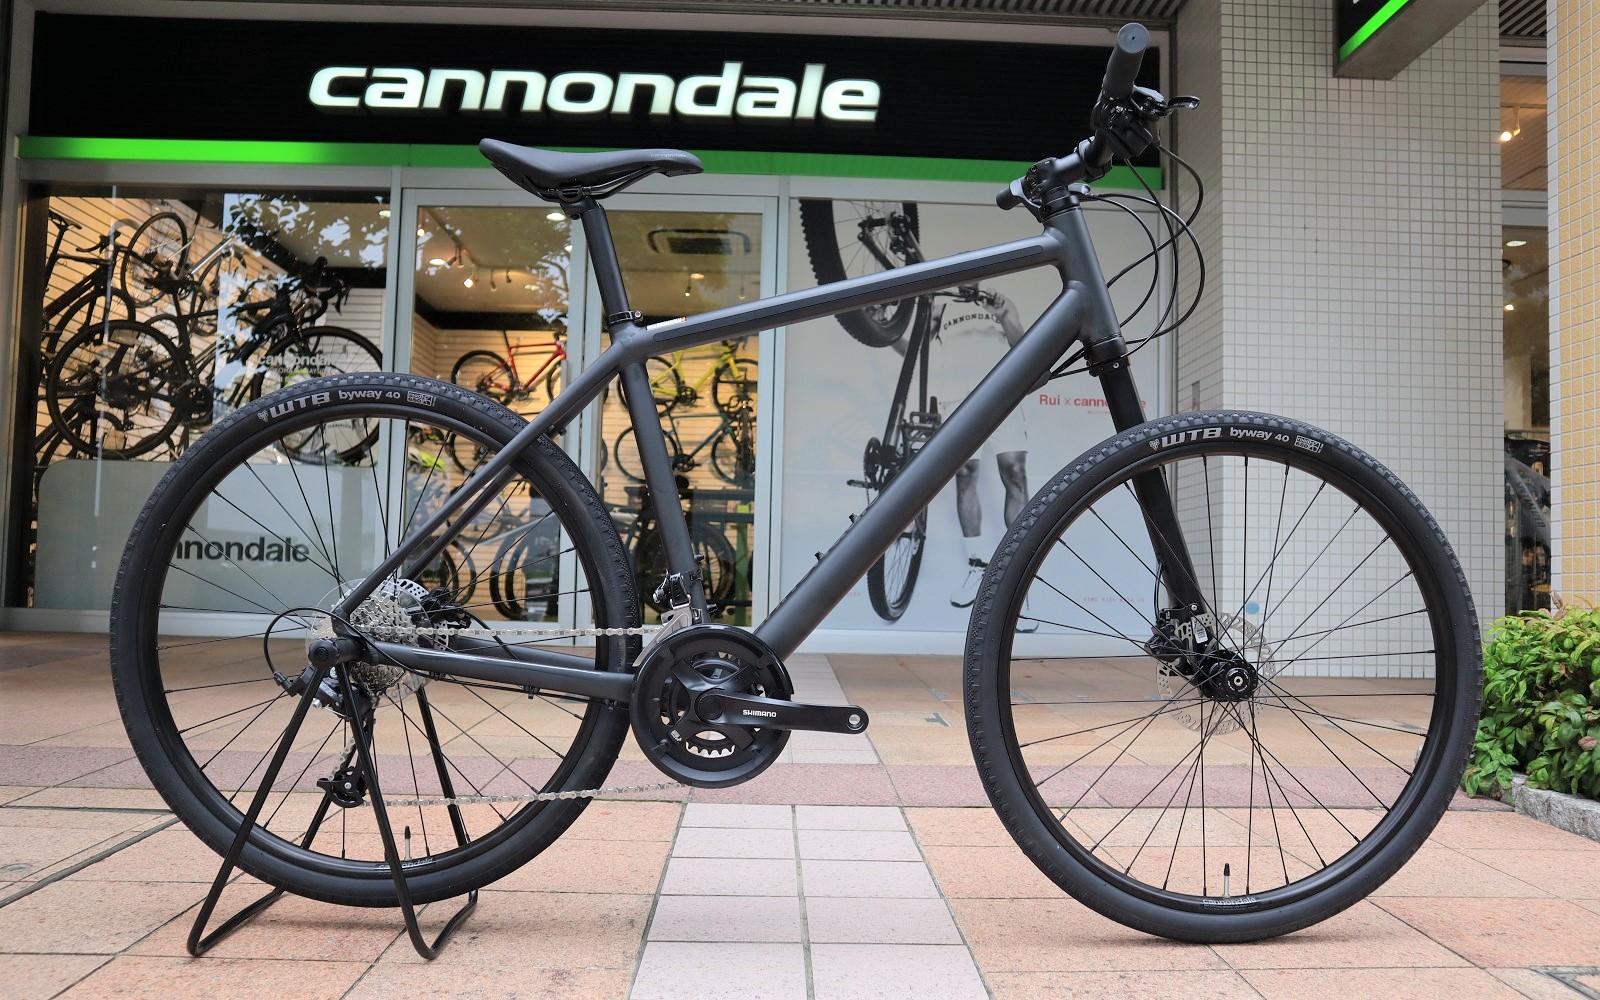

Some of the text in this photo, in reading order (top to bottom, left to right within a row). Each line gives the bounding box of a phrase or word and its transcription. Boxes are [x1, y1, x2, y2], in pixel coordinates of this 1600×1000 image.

[308, 61, 882, 123] cannondale
[269, 391, 331, 418] WTB
[338, 390, 383, 400] byway
[385, 391, 401, 399] 40
[1039, 394, 1060, 406] Rui
[1073, 398, 1146, 408] canne
[1161, 426, 1290, 448] WTB byway 40
[176, 537, 310, 563] nondale
[742, 709, 777, 718] SHIMANO
[377, 857, 434, 870] caondale
[1202, 896, 1257, 905] cannondale
